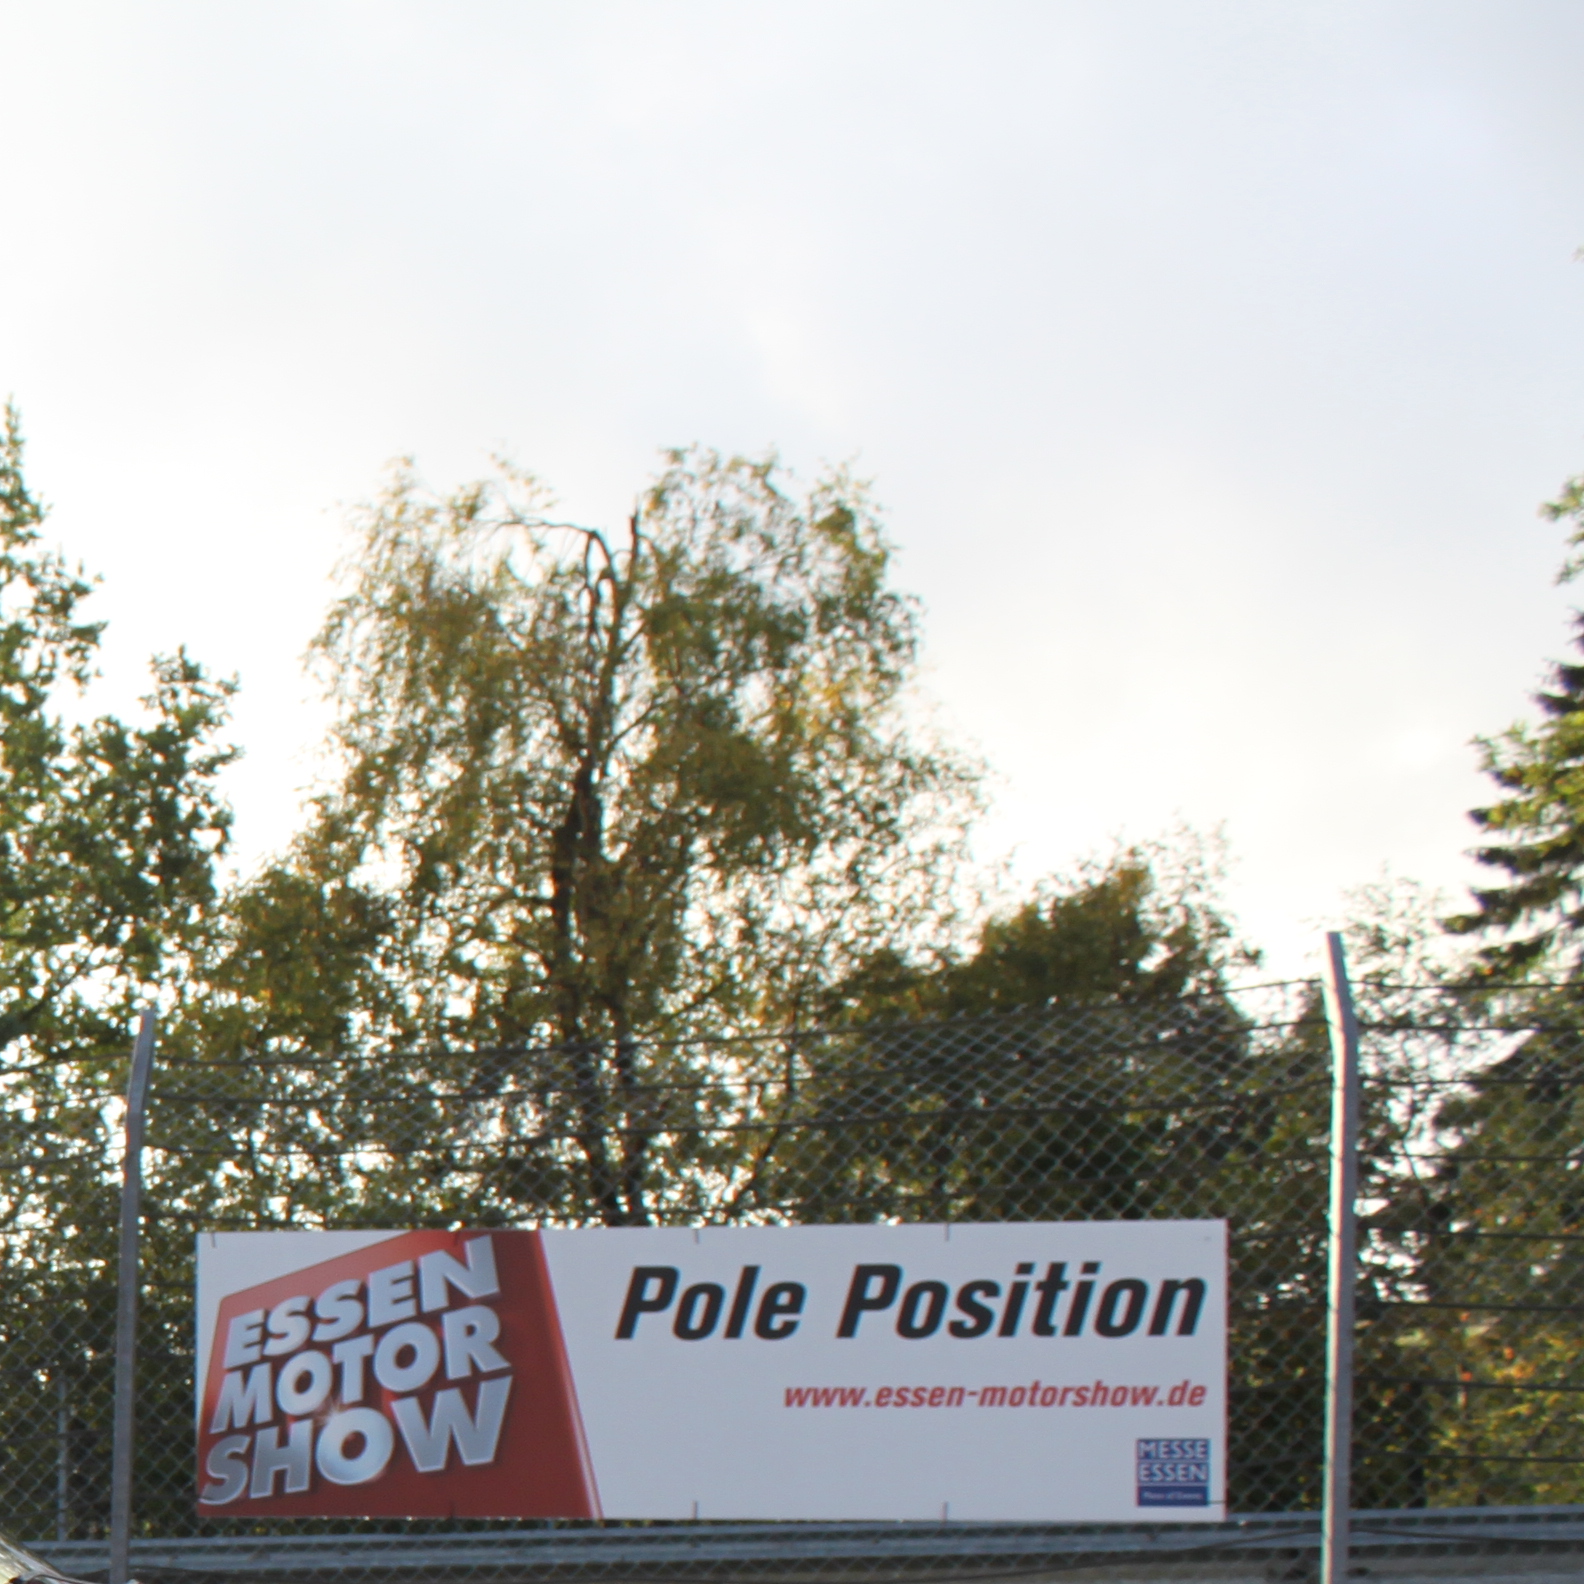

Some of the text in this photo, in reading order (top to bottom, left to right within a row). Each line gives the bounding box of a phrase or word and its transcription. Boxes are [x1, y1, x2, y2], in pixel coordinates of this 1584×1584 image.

[225, 1234, 501, 1367] ESSEN
[615, 1259, 1208, 1342] Pole Position
[209, 1303, 511, 1436] MOTOR
[782, 1379, 1208, 1409] www.essen-motorshow.de
[198, 1375, 513, 1505] SHOW
[1138, 1441, 1207, 1459] MESSE
[1138, 1463, 1207, 1482] ESSEN
